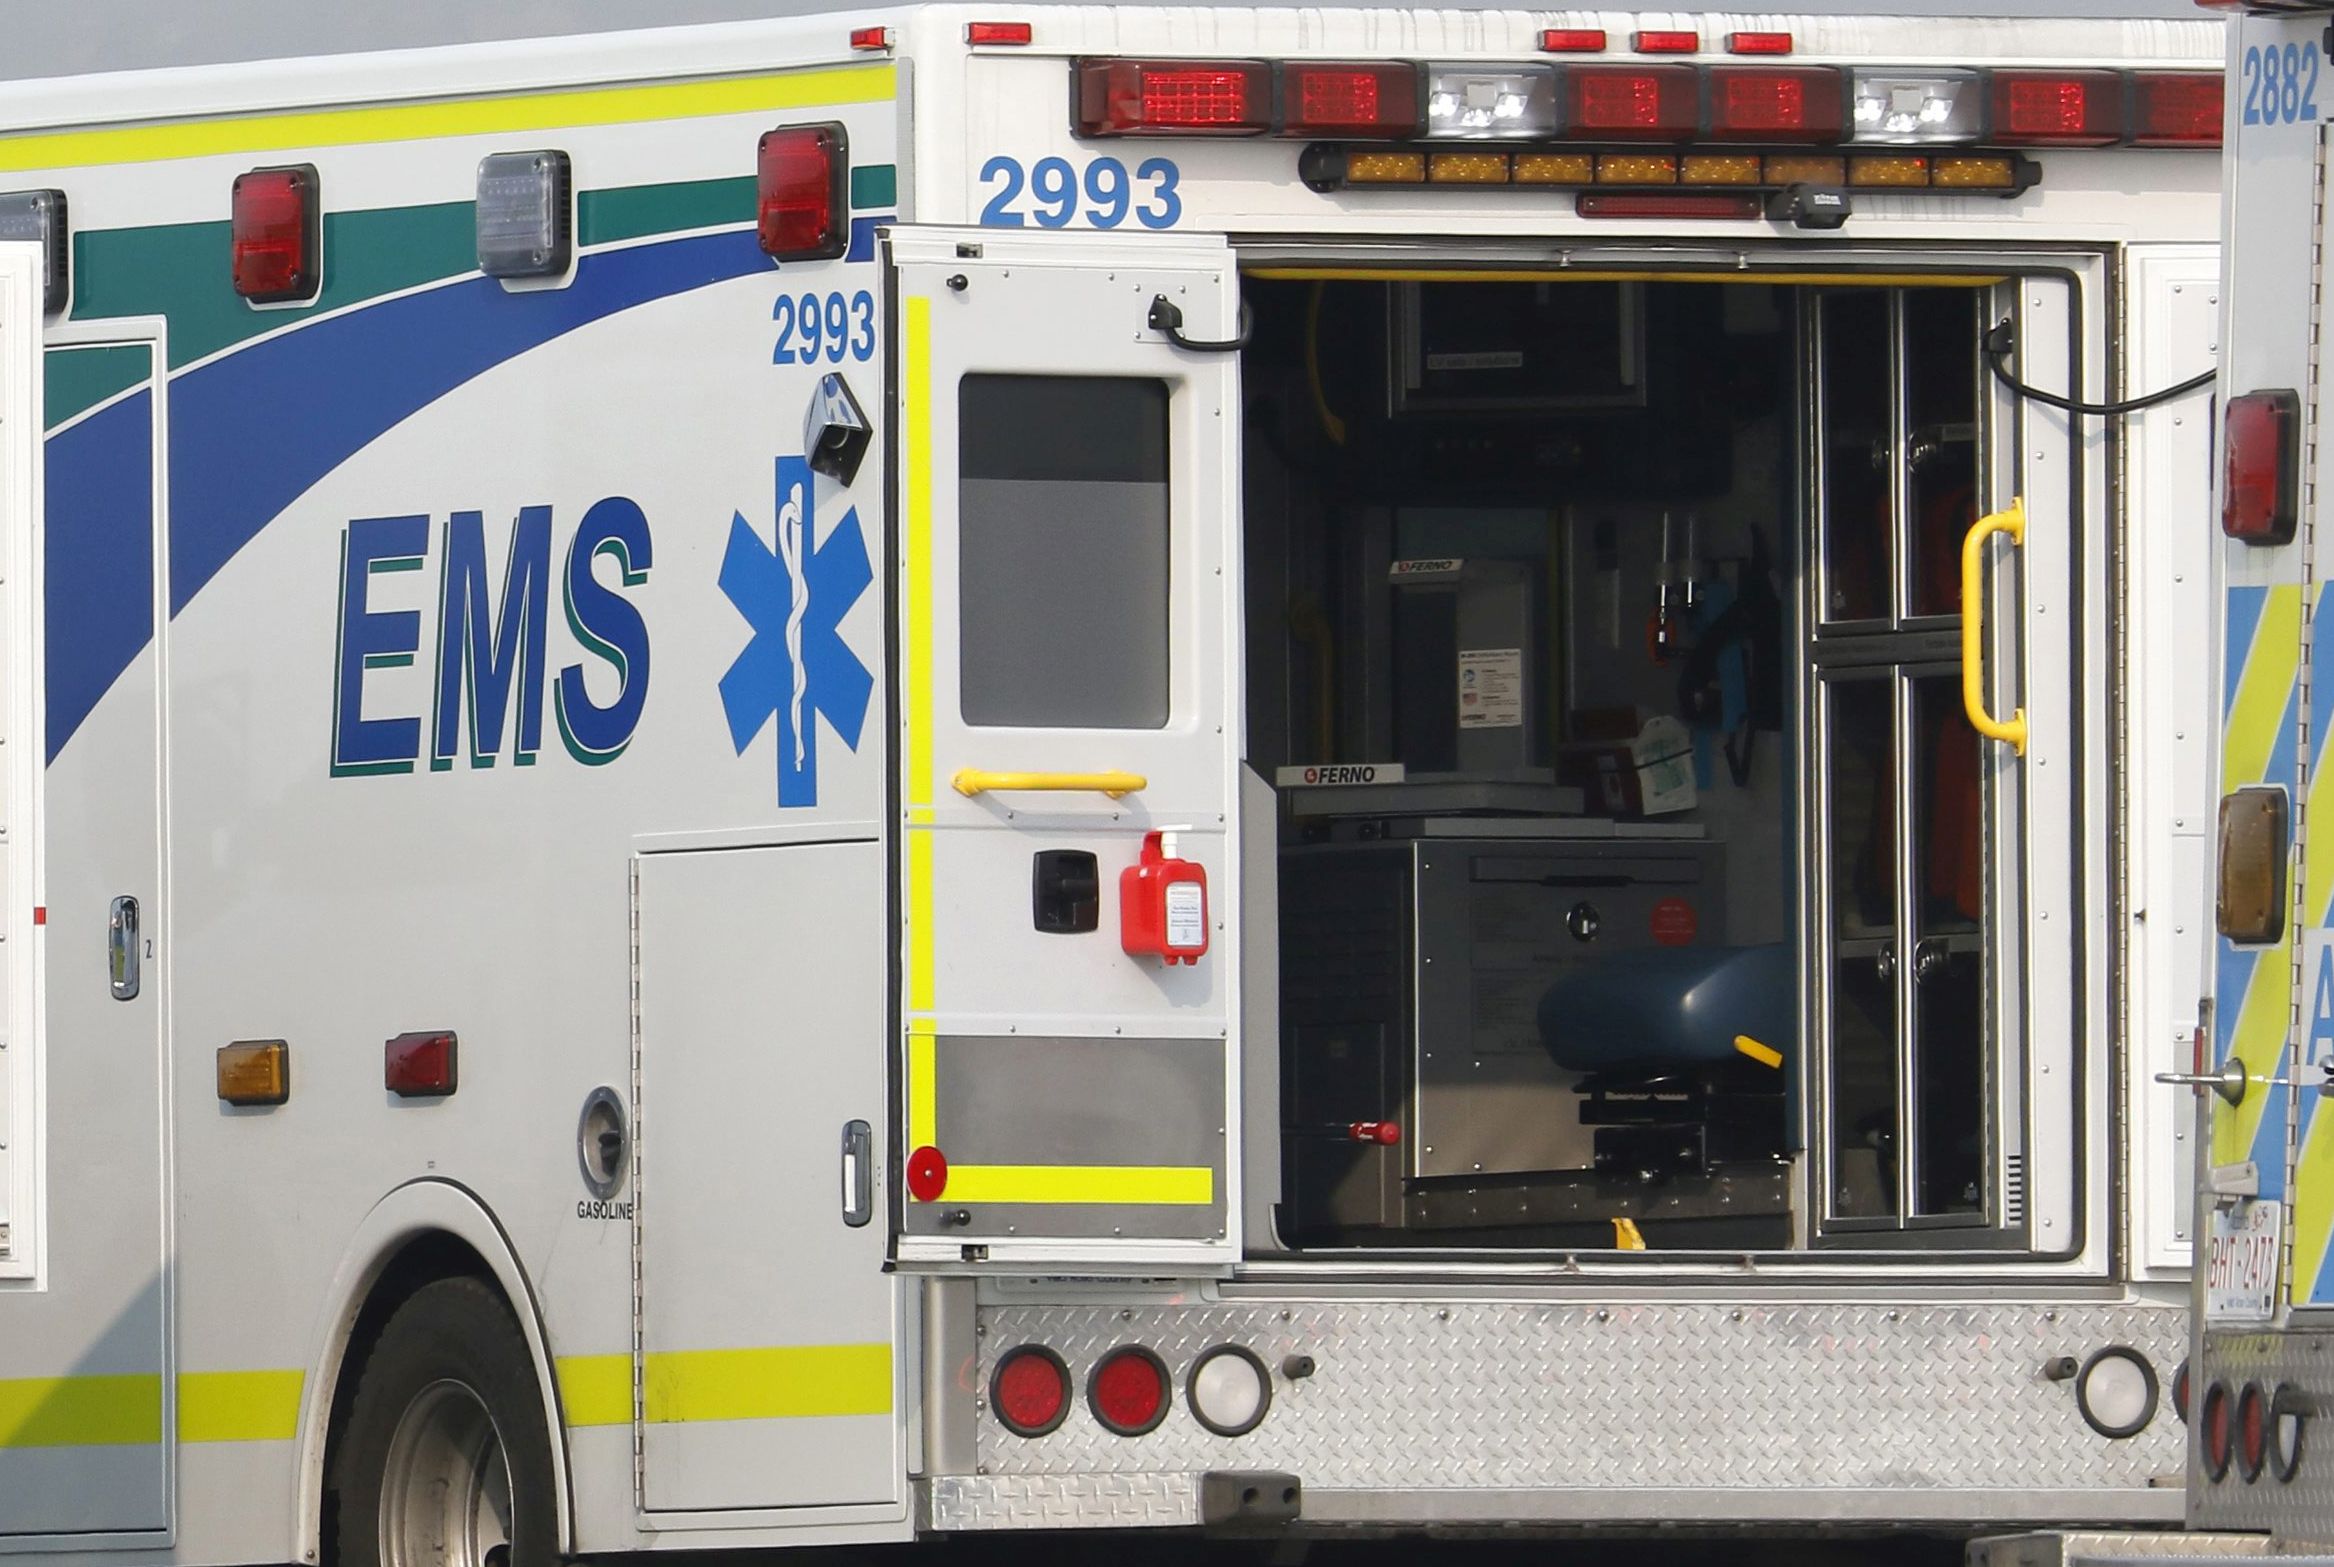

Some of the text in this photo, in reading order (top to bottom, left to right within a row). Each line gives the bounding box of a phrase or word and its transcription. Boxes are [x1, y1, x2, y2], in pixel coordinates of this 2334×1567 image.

[2243, 41, 2318, 125] 2882
[980, 156, 1182, 229] 2993
[773, 290, 875, 365] 2993
[330, 496, 653, 777] EMS
[1319, 766, 1375, 783] FERNO
[146, 939, 152, 959] 2
[577, 1201, 633, 1220] GASOLINE
